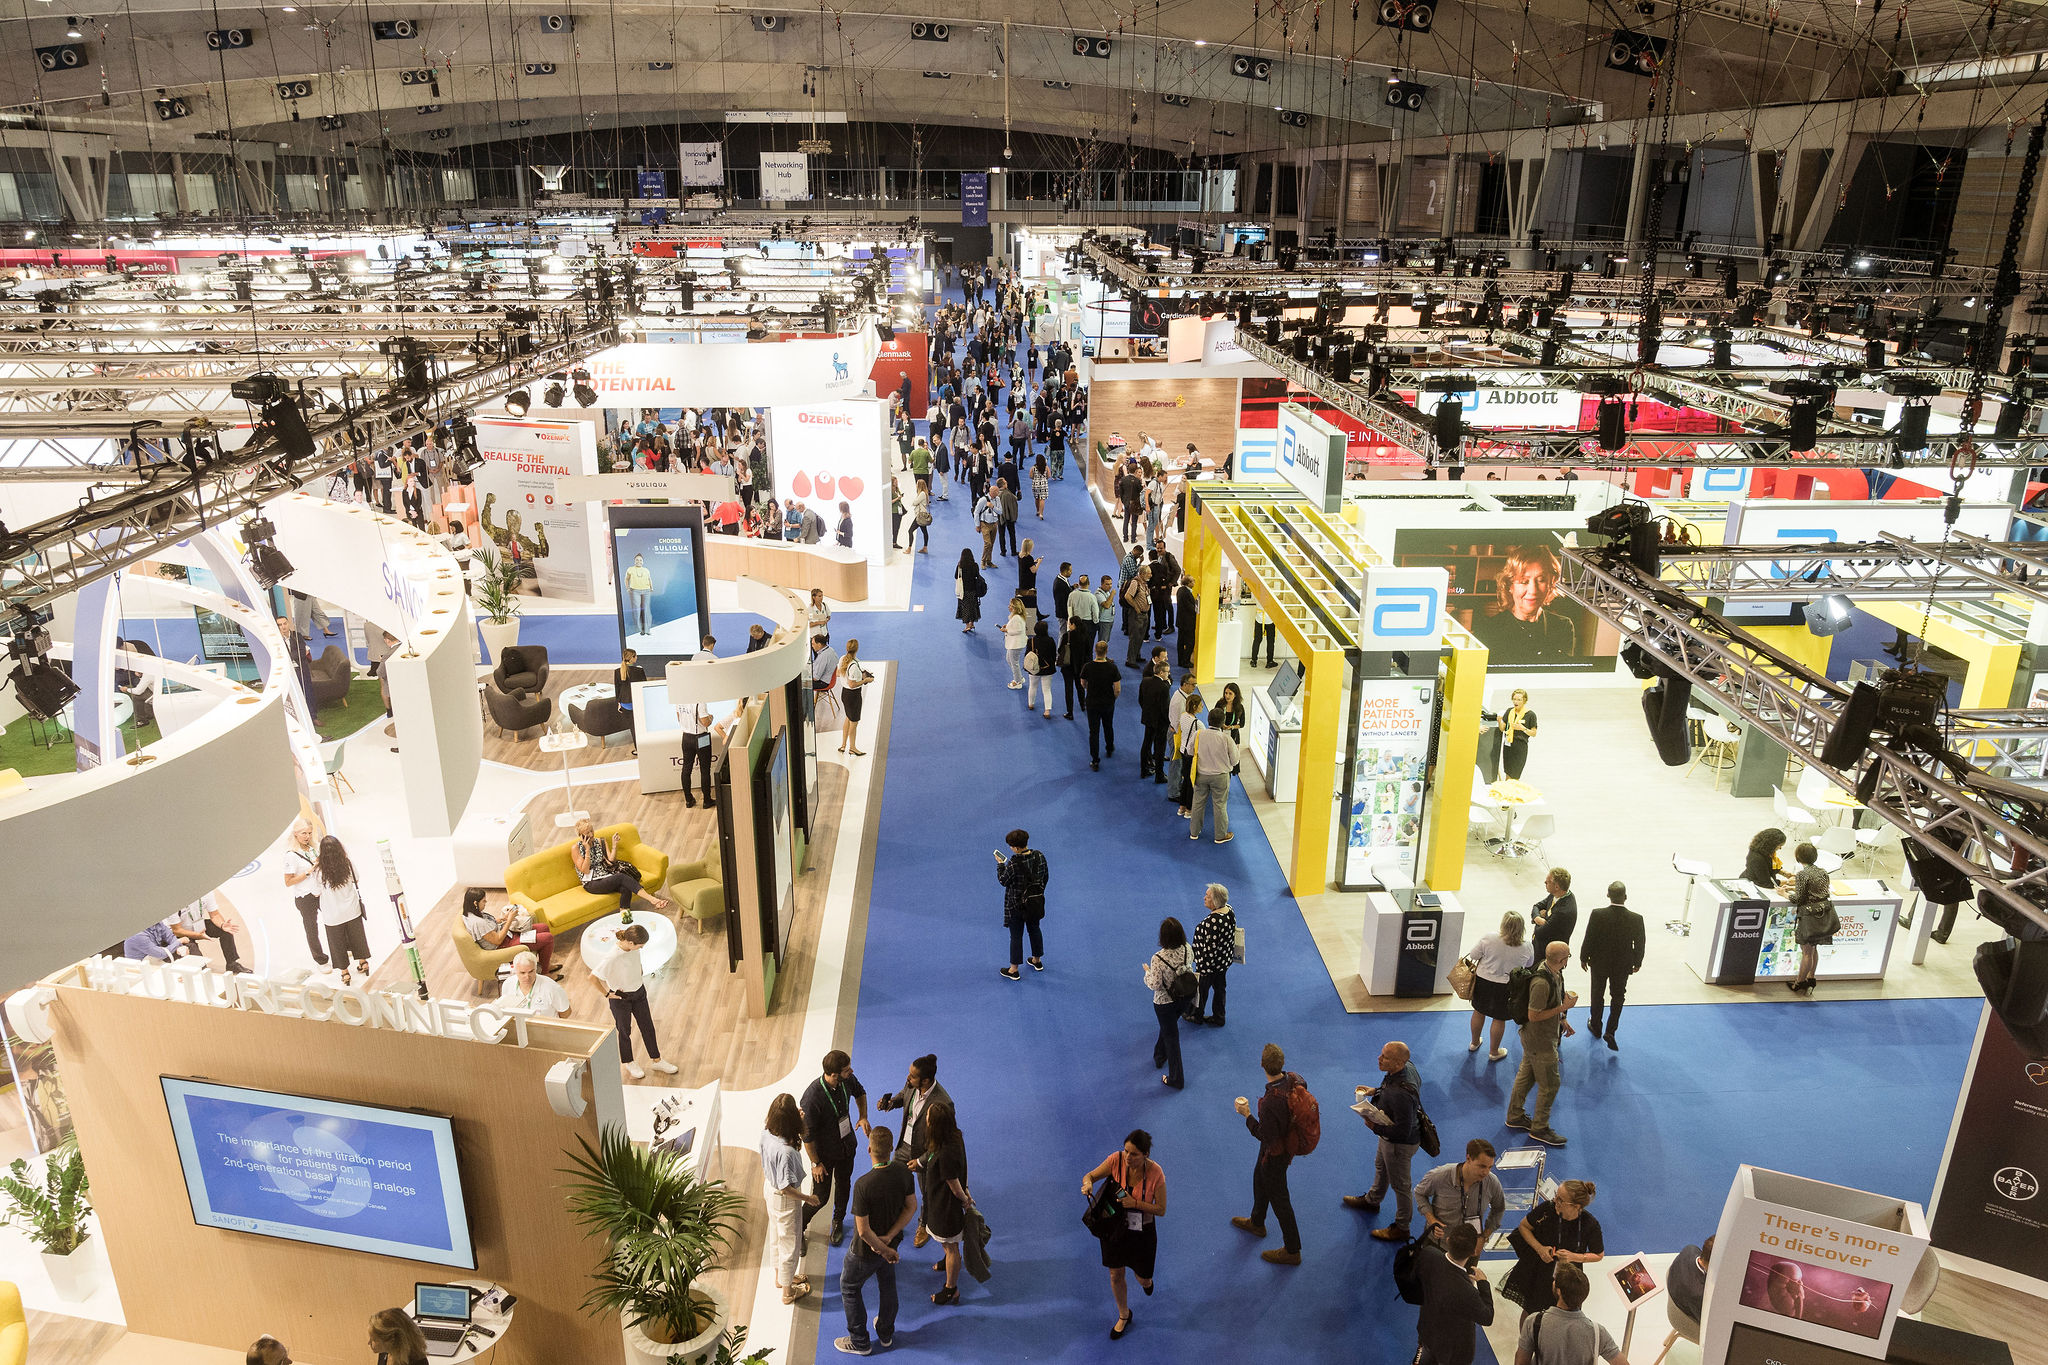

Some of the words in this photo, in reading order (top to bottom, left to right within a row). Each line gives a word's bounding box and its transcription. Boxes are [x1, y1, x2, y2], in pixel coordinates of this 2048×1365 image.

[592, 361, 625, 375] THE
[590, 377, 676, 391] OTENTIAL
[1135, 400, 1177, 408] AstraZeneca
[1486, 390, 1559, 404] Abbott
[1358, 431, 1372, 442] IN
[483, 451, 523, 463] REALISE
[527, 454, 544, 464] THE
[1296, 443, 1320, 478] Abbott
[517, 464, 571, 476] POTENTIAL
[1363, 698, 1400, 709] MORE
[1363, 709, 1415, 719] PATIENTS
[1362, 719, 1388, 729] CAN
[1391, 719, 1410, 729] DO
[1412, 719, 1422, 729] IT
[1838, 915, 1856, 923] ORE
[1731, 931, 1760, 939] Abbott
[216, 1132, 239, 1145] The
[240, 1136, 299, 1154] importance
[302, 1146, 314, 1157] of
[315, 1148, 333, 1159] the
[335, 1151, 375, 1166] titration
[377, 1159, 412, 1172] period
[278, 1153, 293, 1164] for
[295, 1158, 338, 1172] patients
[340, 1165, 354, 1174] on
[223, 1156, 303, 1177] 2nd-generation
[304, 1169, 334, 1182] basal
[336, 1173, 371, 1188] insulin
[373, 1181, 417, 1197] analogs
[1997, 1175, 2035, 1192] BAYER
[2009, 1170, 2023, 1198] BAYER
[212, 1215, 246, 1229] SANOFI
[1764, 1212, 1840, 1242] There's
[1844, 1233, 1900, 1256] more
[1759, 1231, 1781, 1248] to
[1784, 1233, 1873, 1268] discover
